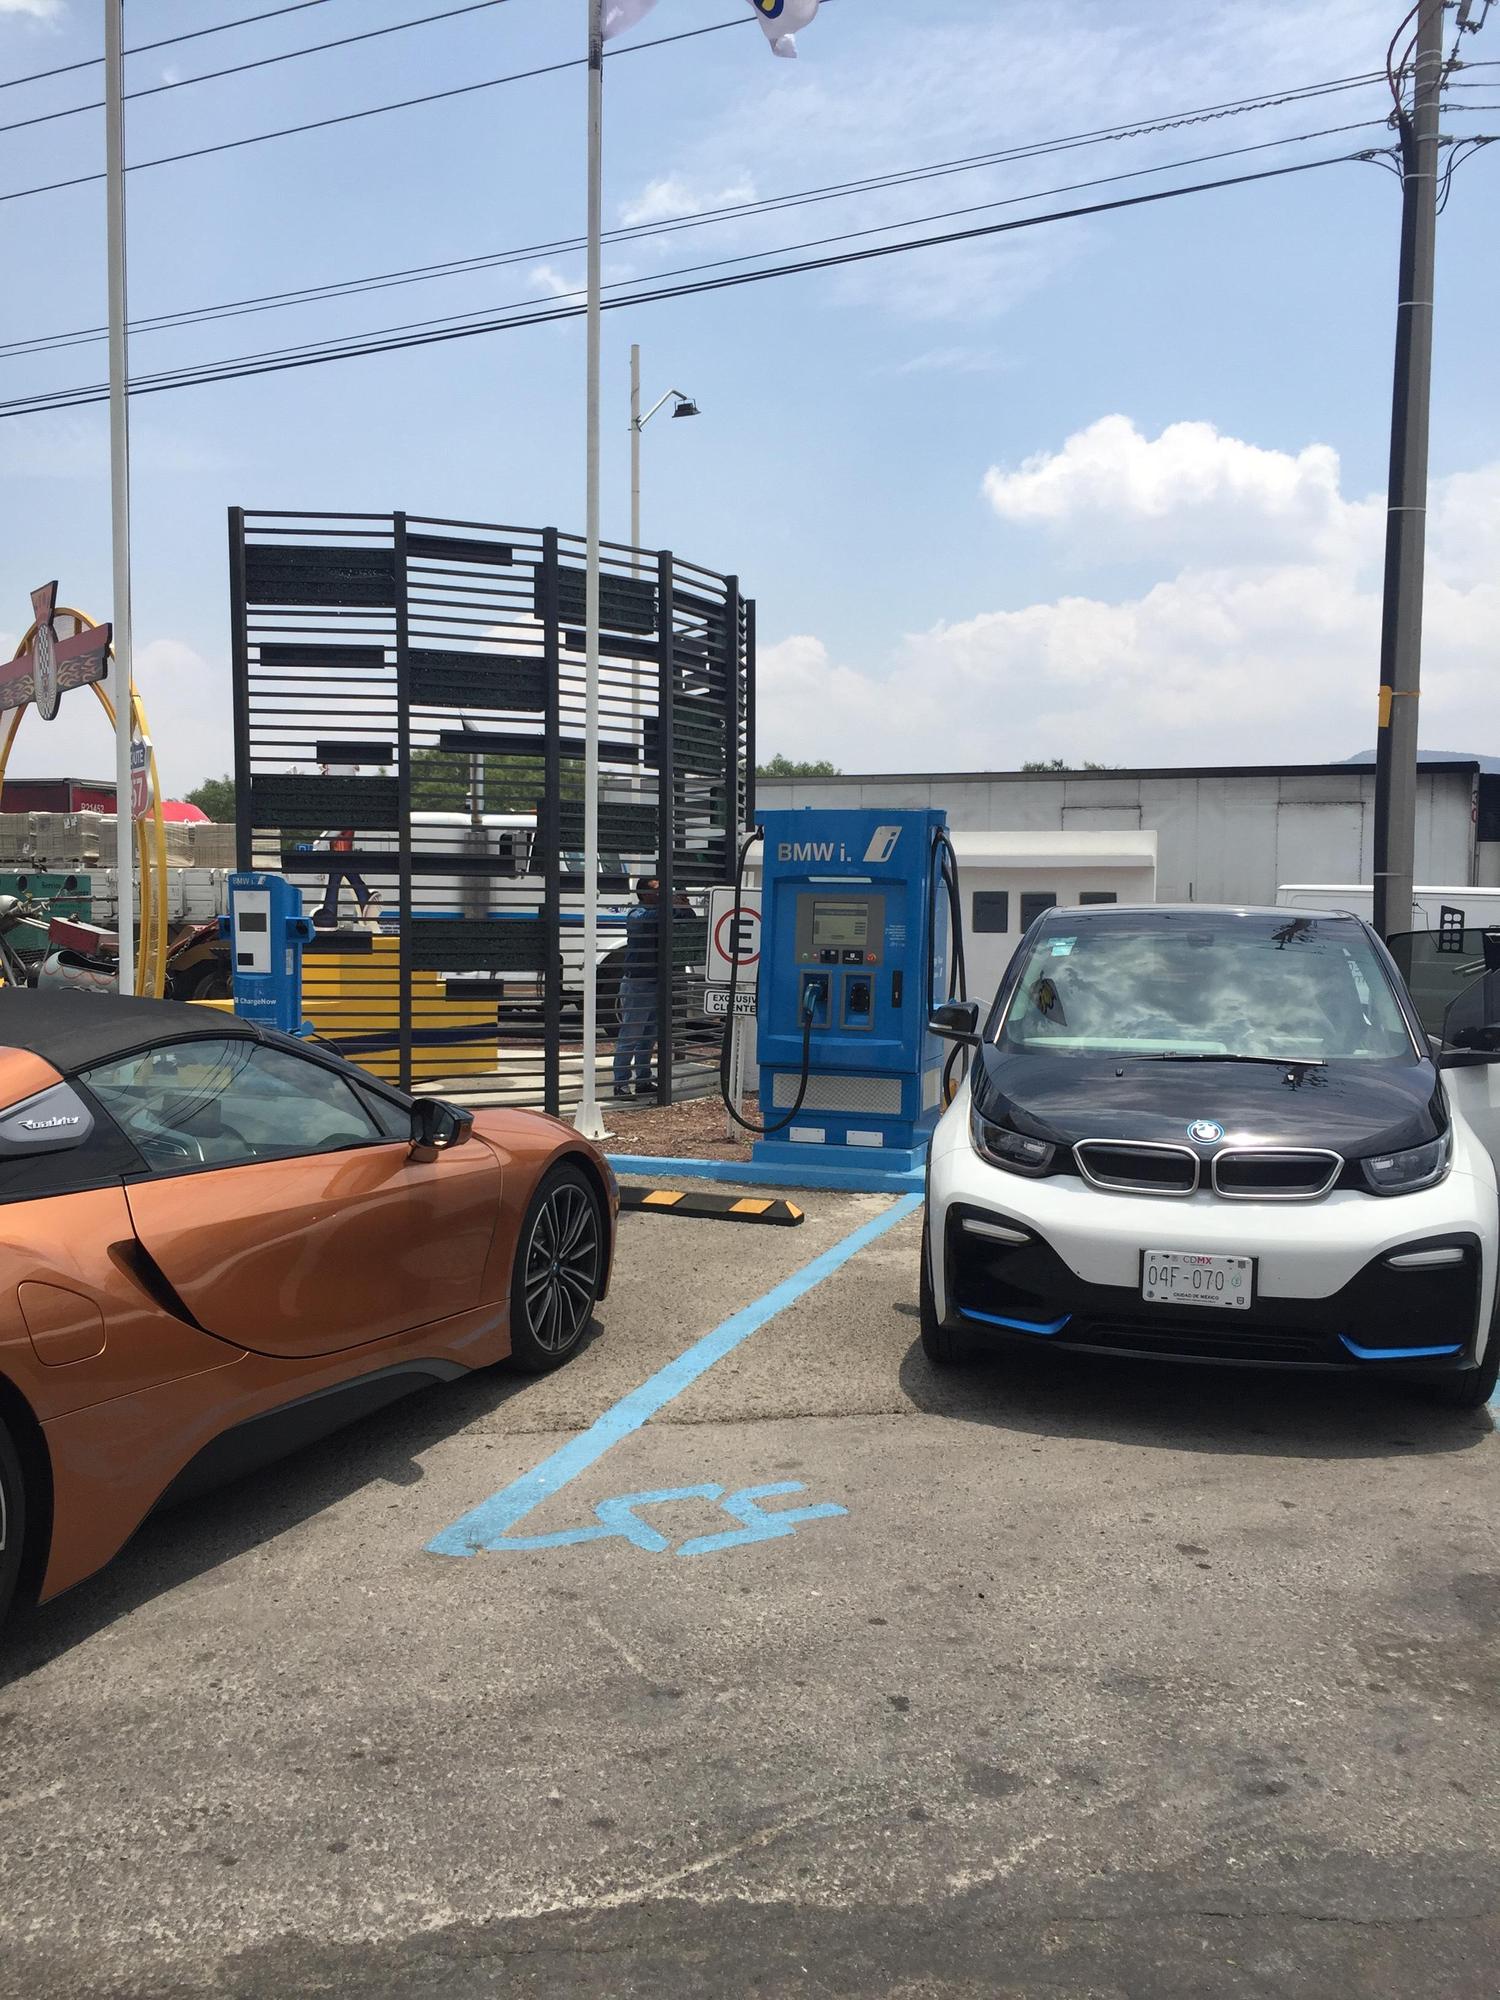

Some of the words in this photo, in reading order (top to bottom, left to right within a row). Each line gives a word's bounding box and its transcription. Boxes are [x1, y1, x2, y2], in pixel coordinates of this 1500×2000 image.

[778, 843, 834, 861] BMW
[729, 919, 754, 954] E
[240, 998, 276, 1006] ChargeNow
[713, 994, 756, 1004] EXCUSIV
[713, 1003, 756, 1013] CLNTE
[1183, 1255, 1212, 1265] CDMX
[1148, 1265, 1224, 1291] 04F-070
